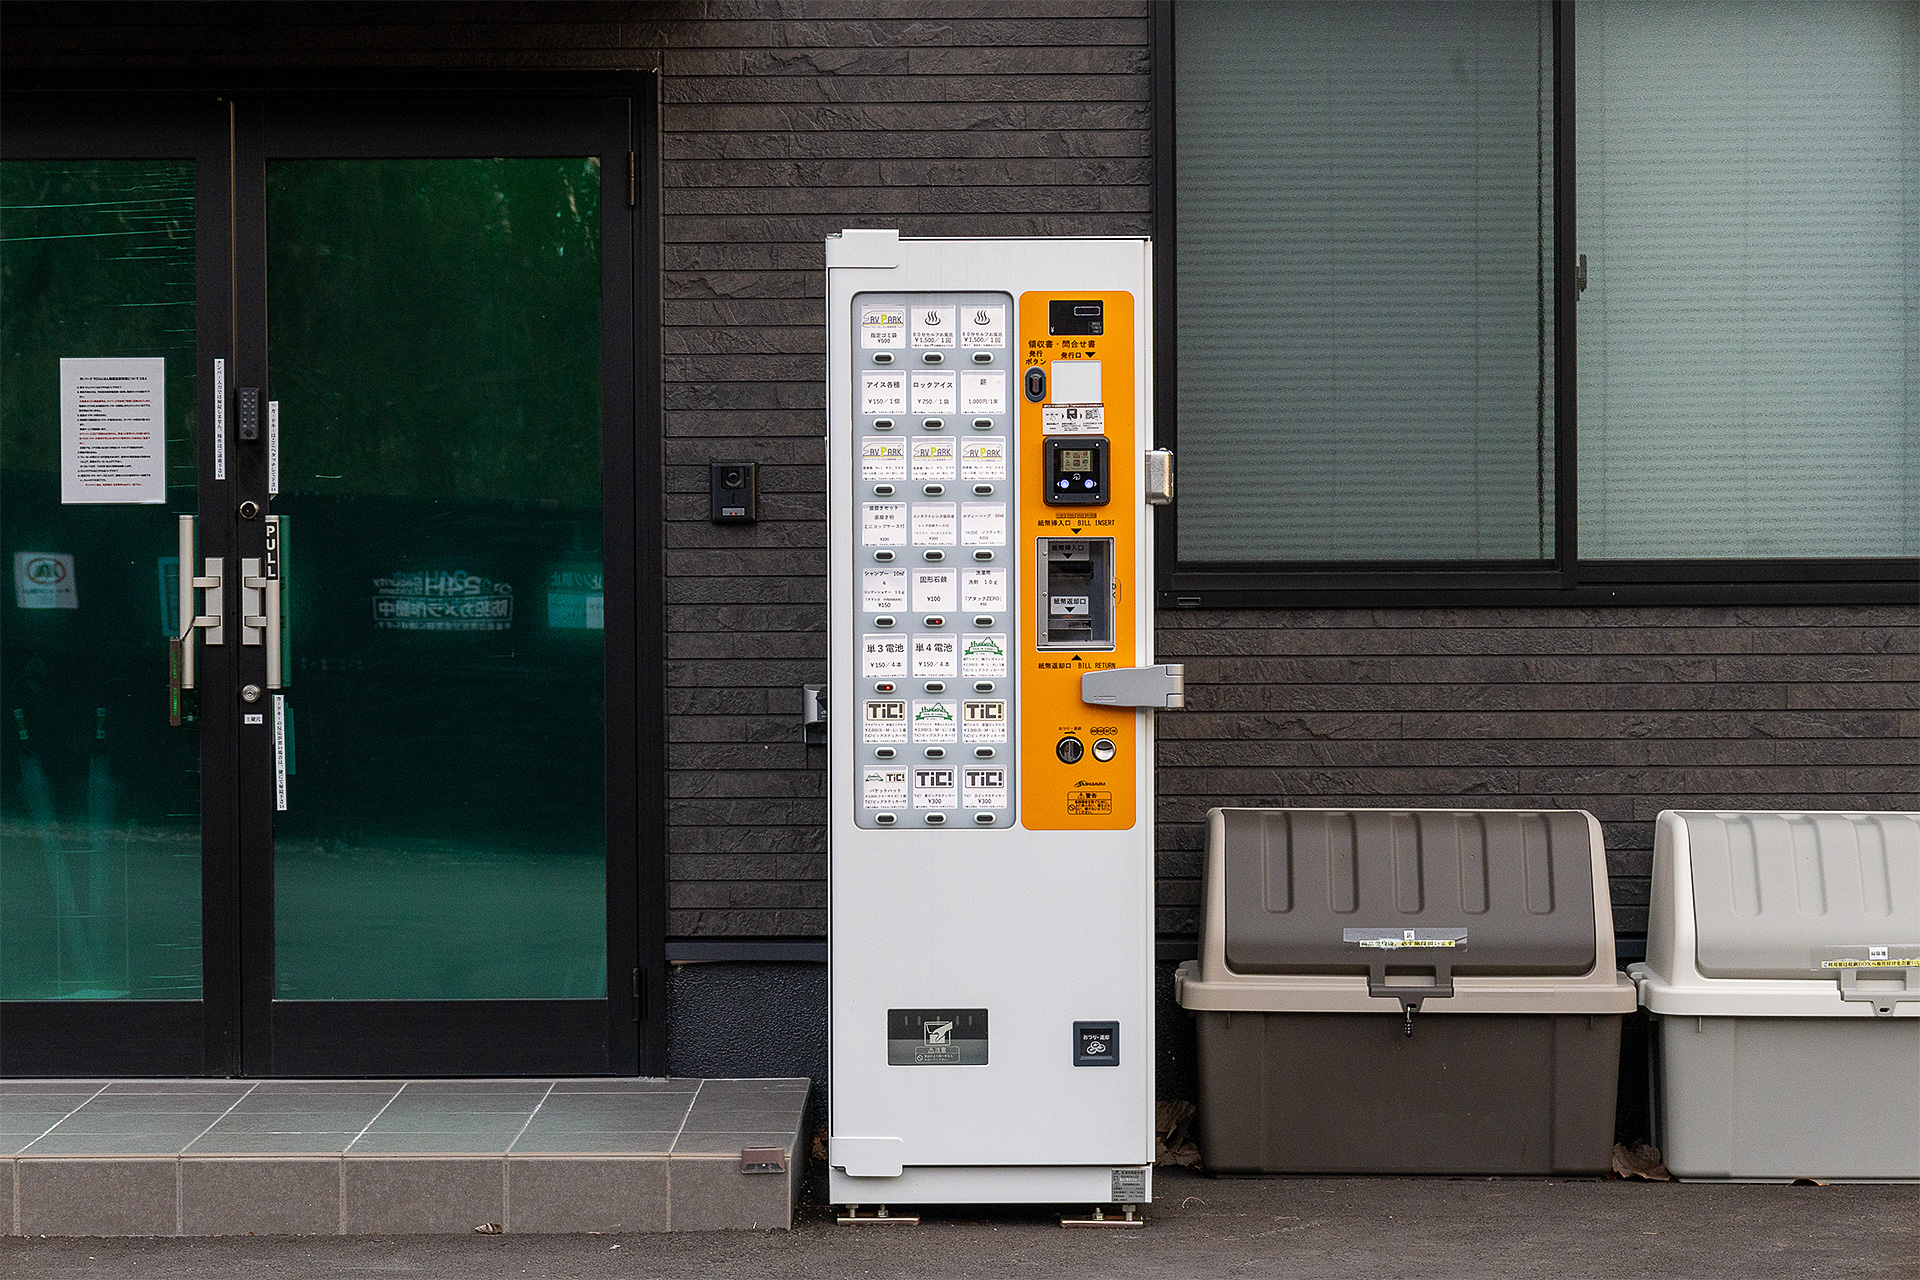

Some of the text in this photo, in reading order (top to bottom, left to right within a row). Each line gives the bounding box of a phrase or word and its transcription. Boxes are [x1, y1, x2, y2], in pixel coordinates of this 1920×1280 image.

[1028, 340, 1096, 349] 領収書・問合せ書
[1029, 350, 1043, 358] 発行
[1025, 358, 1047, 366] ボタン
[867, 381, 900, 389] アイス各種
[913, 381, 954, 389] ロックアイス
[266, 525, 276, 578] PULL
[867, 643, 905, 653] 単3電池
[915, 643, 953, 653] 単4電池
[868, 703, 903, 719] TiC!
[966, 704, 1002, 719] TiC!
[886, 773, 905, 782] TiC!
[916, 771, 952, 786] TiC!
[966, 771, 1003, 786] TiC!
